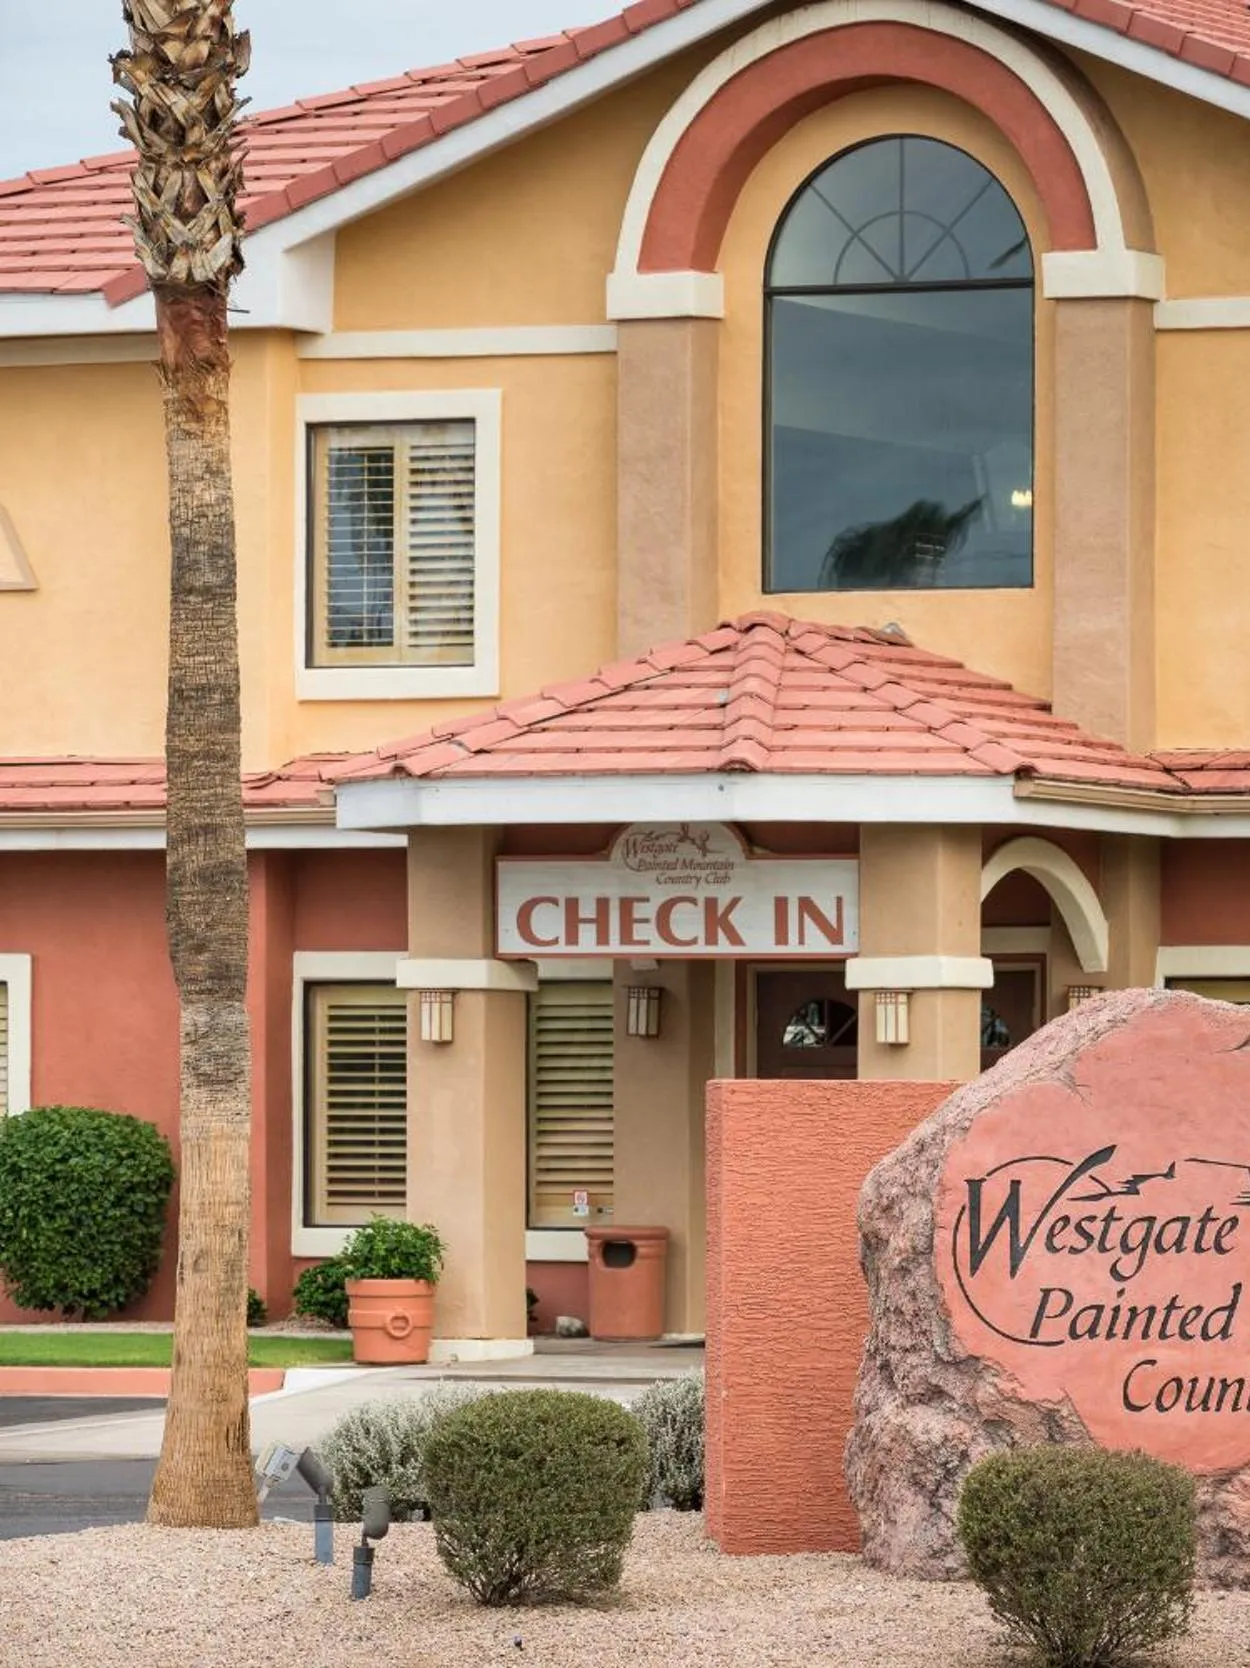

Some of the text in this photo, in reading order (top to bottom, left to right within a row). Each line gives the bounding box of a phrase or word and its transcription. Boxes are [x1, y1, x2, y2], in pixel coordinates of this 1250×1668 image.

[656, 871, 731, 890] Country Club
[680, 858, 734, 871] Mountain
[516, 896, 844, 947] CHECK IN
[963, 1144, 1240, 1282] Westgate
[1029, 1283, 1242, 1343] Painted
